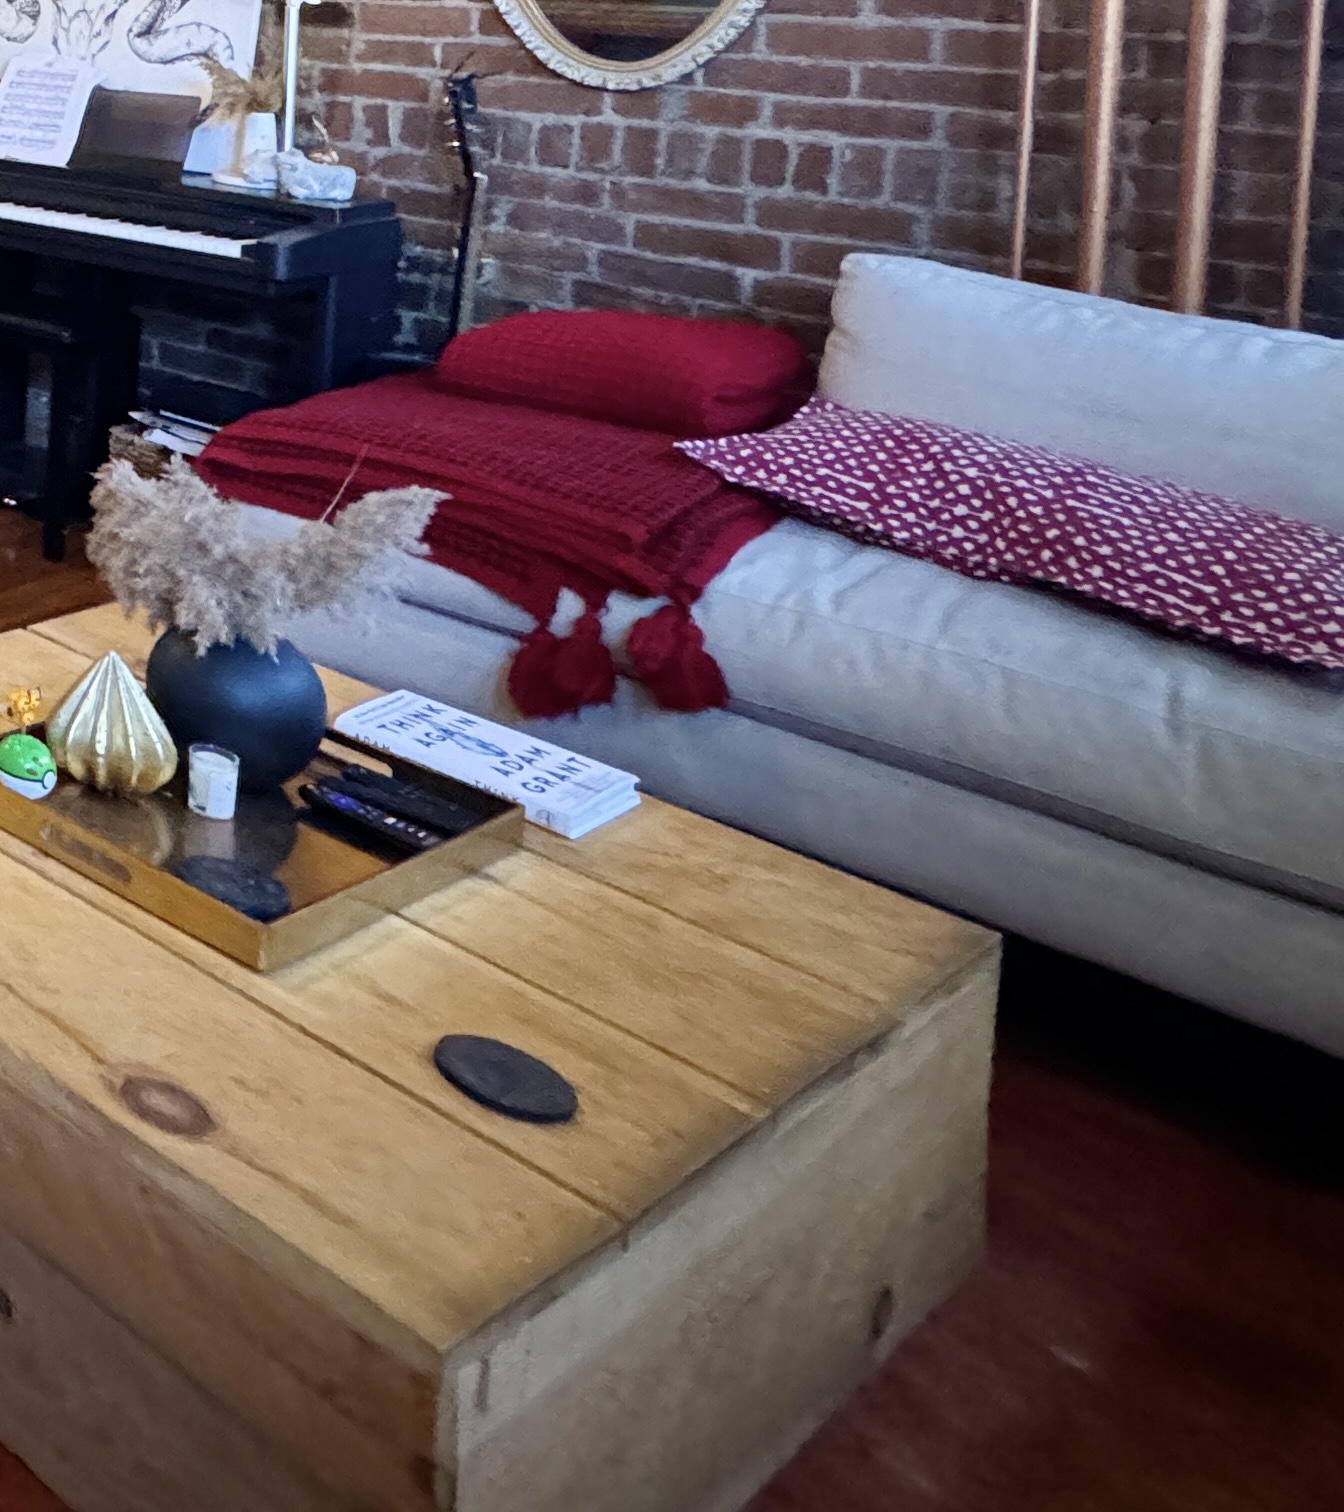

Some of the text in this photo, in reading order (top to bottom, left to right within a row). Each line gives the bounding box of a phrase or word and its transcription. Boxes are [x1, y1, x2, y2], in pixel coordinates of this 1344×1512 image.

[376, 703, 448, 734] THINK
[414, 716, 479, 748] AGAIN
[490, 744, 552, 778] ADAM
[521, 756, 593, 794] GRANT
